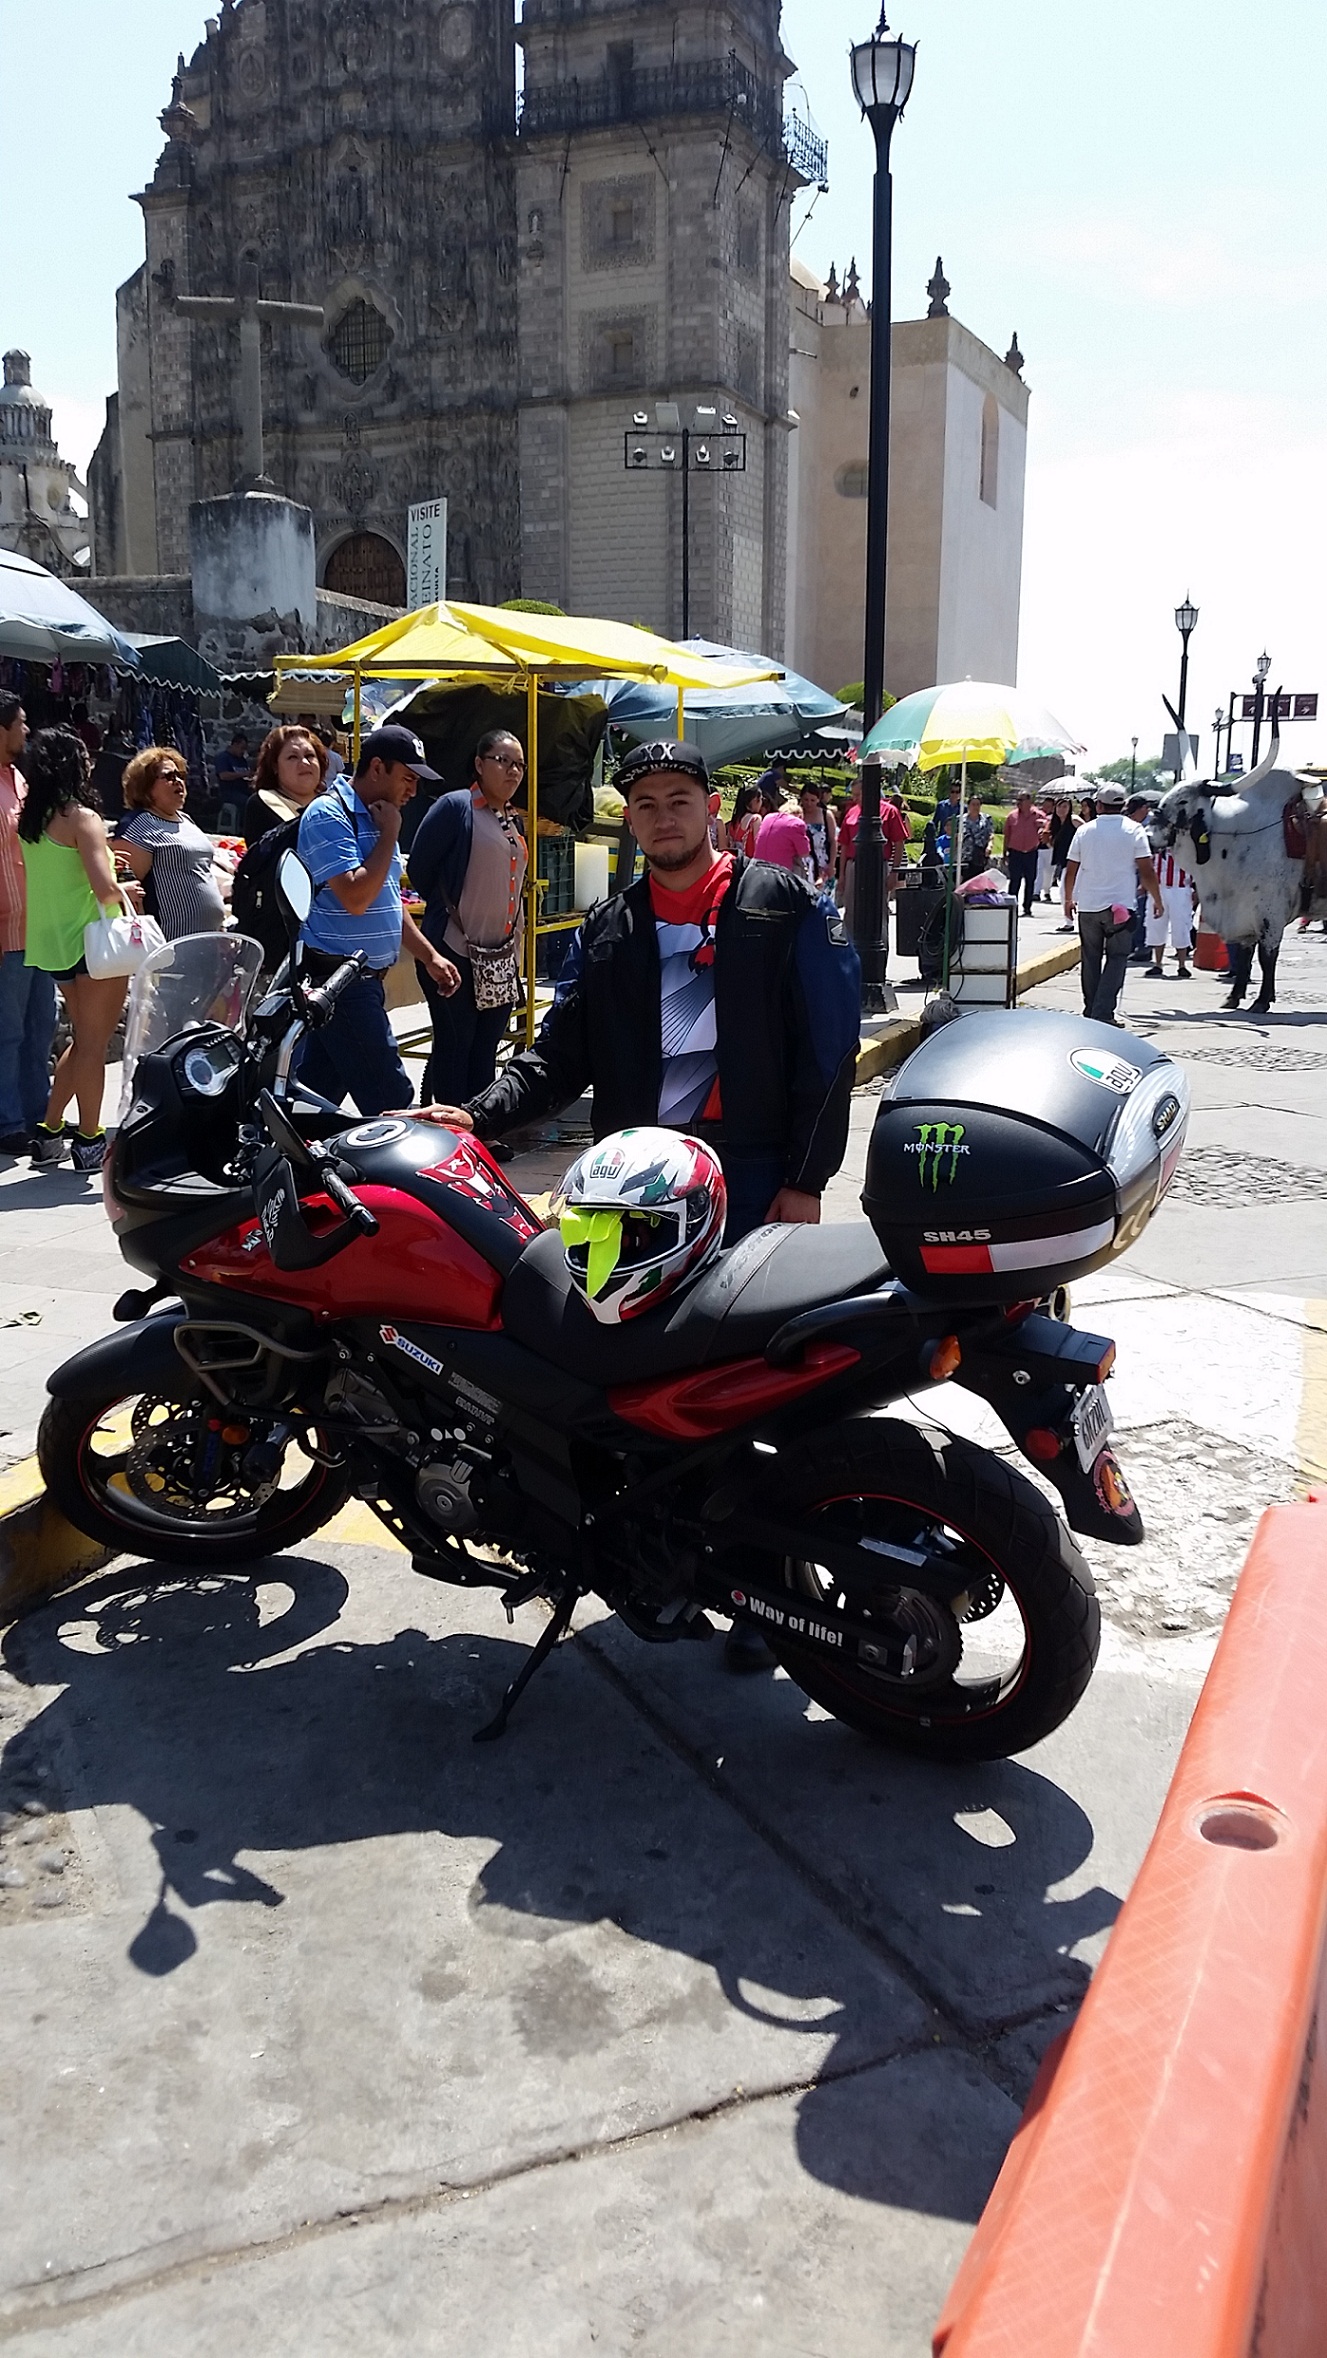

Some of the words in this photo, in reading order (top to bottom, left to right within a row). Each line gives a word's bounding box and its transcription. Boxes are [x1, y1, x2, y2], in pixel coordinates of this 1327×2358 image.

[410, 503, 441, 522] VISITE
[903, 1141, 972, 1155] MONSTER
[922, 1228, 992, 1243] SH45
[397, 1337, 442, 1372] SUZUKI
[749, 1596, 785, 1626] Way
[788, 1615, 806, 1633] of
[808, 1620, 844, 1648] life!
